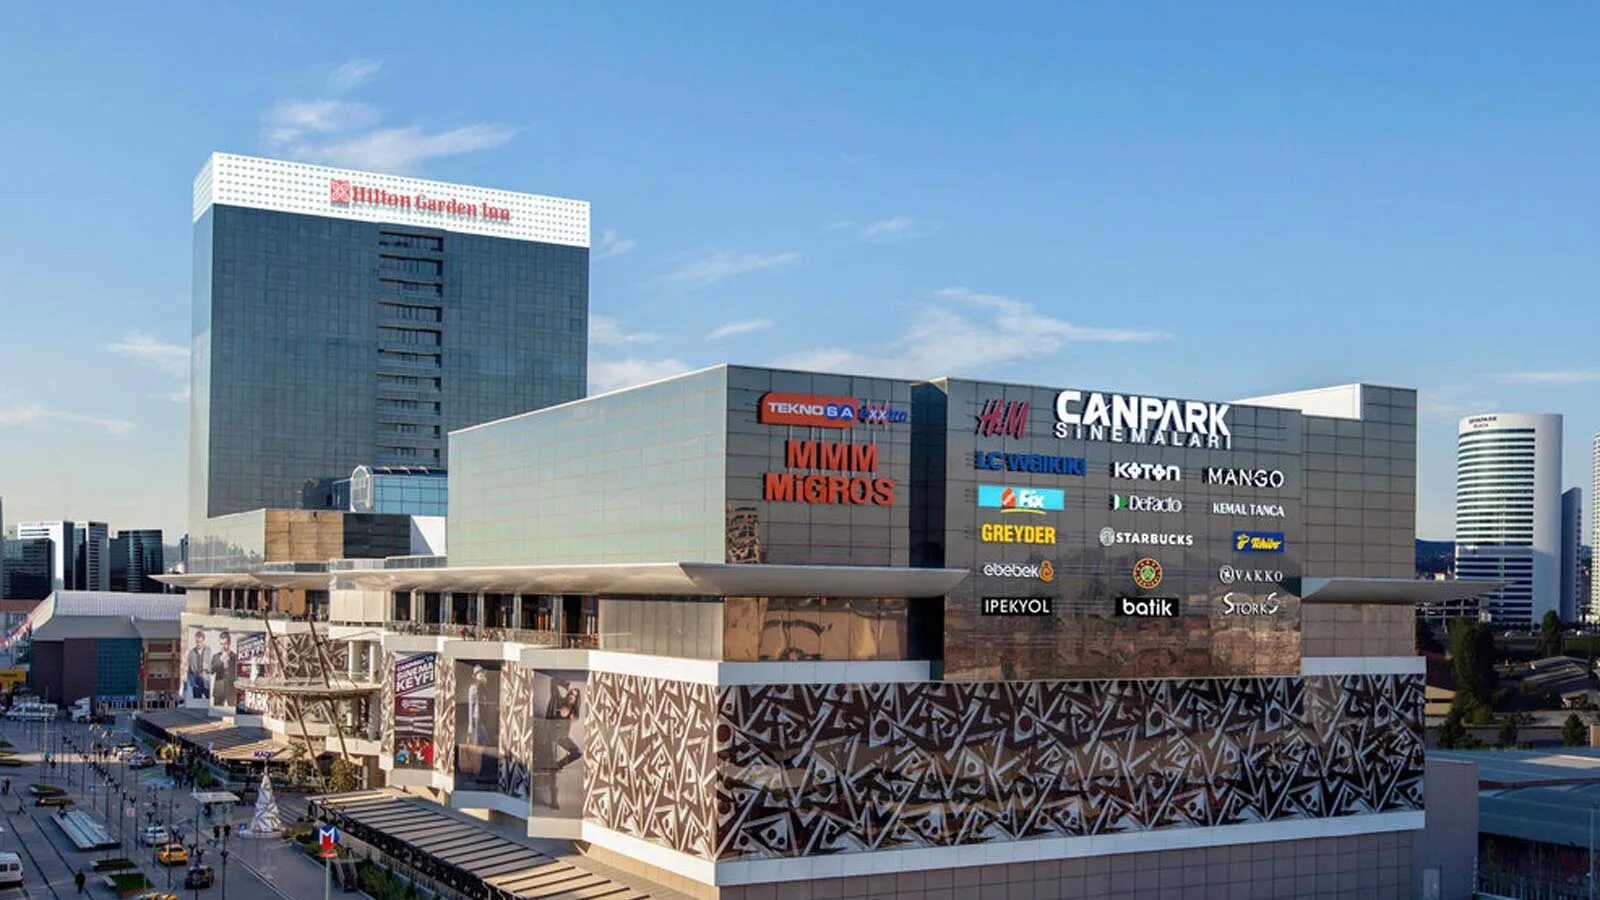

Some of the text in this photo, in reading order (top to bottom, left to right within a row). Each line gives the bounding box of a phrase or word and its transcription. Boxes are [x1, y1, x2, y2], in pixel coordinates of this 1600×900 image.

[352, 185, 511, 220] Hilton Garden Inn
[768, 402, 853, 419] TEKNOSA
[978, 399, 1030, 439] H&M
[1056, 390, 1231, 436] CANPARK
[788, 440, 879, 473] MMM
[977, 451, 1003, 471] LC
[1208, 467, 1285, 487] MANGO
[1020, 489, 1045, 508] Fix
[1129, 494, 1182, 513] DeFacto
[1213, 502, 1285, 518] KEMAL TANCA
[982, 524, 1056, 544] GREYDER
[1116, 531, 1194, 546] STARBUCKS
[983, 563, 1040, 578] ebebek
[1235, 570, 1284, 583] VAKKO
[985, 598, 1050, 613] IPEKYOL
[1123, 598, 1172, 616] batik
